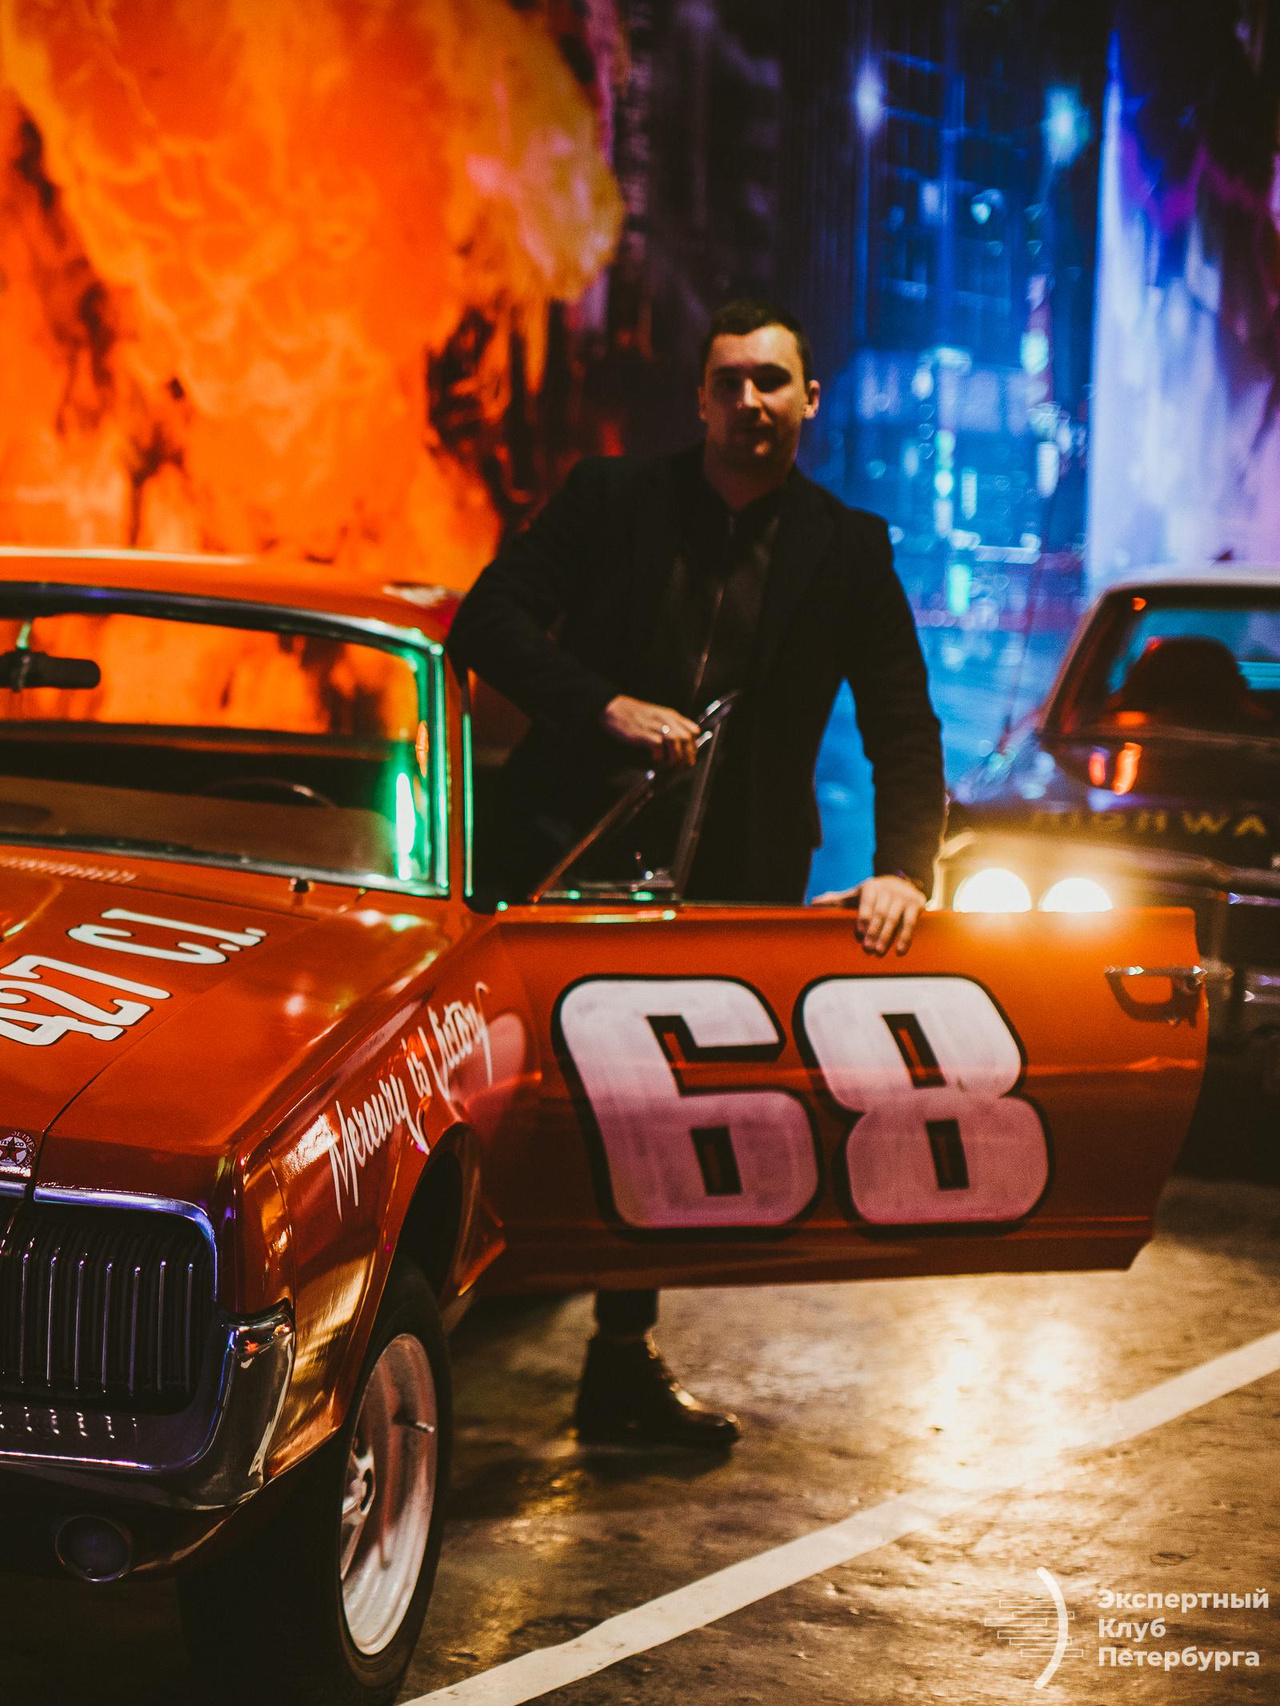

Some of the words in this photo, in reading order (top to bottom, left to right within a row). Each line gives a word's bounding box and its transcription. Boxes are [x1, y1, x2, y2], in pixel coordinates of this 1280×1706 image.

[328, 1073, 431, 1223] Mercury
[401, 1037, 432, 1098] is
[554, 976, 1051, 1236] 68
